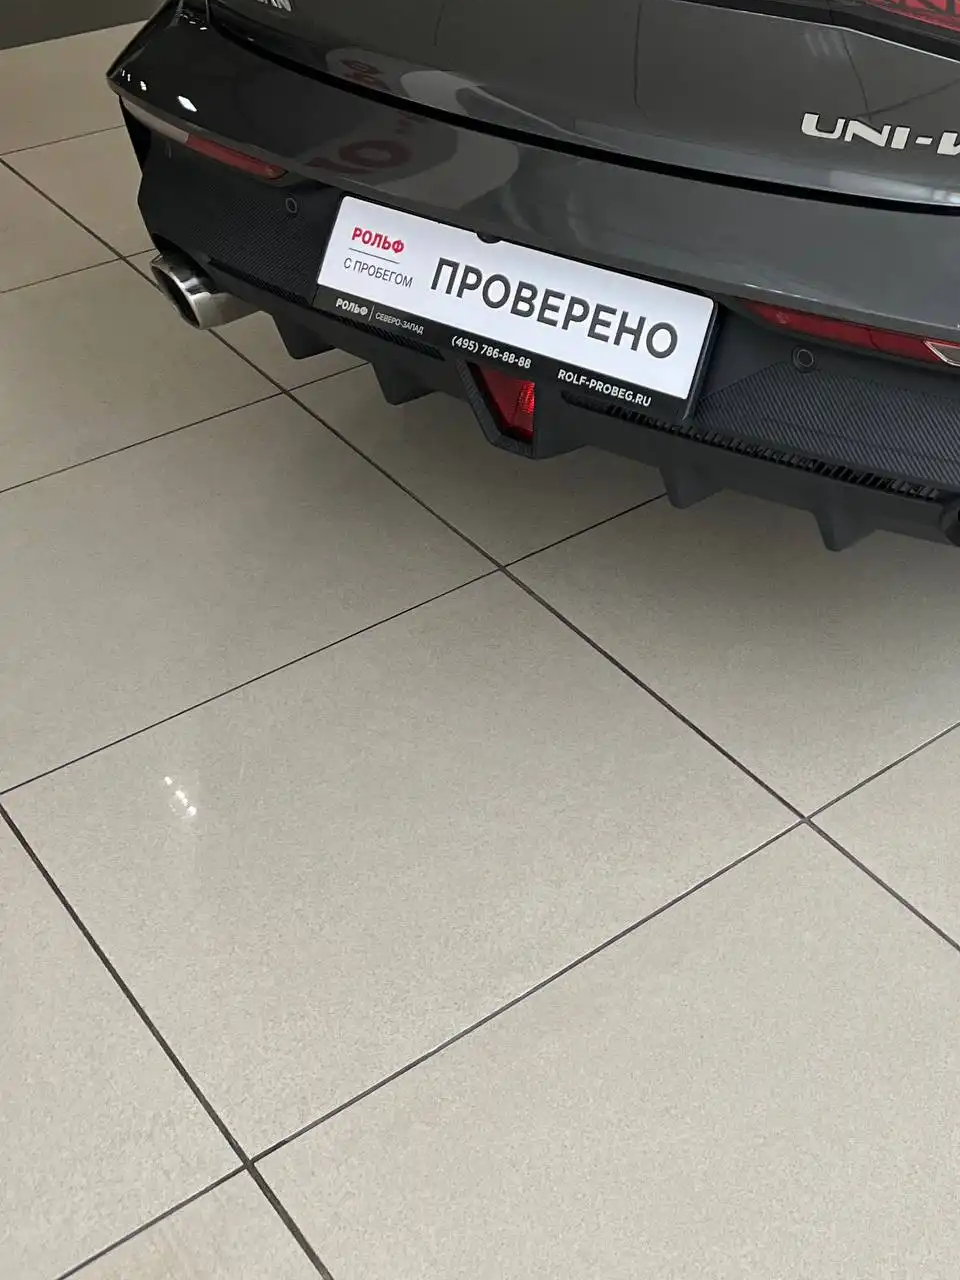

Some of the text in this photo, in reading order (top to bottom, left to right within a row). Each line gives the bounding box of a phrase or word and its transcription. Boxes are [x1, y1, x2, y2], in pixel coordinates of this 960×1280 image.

[351, 227, 405, 254] РОЛЬФ
[343, 257, 414, 288] С ПРОБЕГОМ
[335, 297, 425, 336] РОЛЬФ СЕВЕРО-ЗАПАД
[430, 257, 679, 360] ПРОВЕРЕНО
[451, 335, 533, 370] (495) 786-88-88
[557, 368, 652, 408] ROLF-PROBEG.RU
